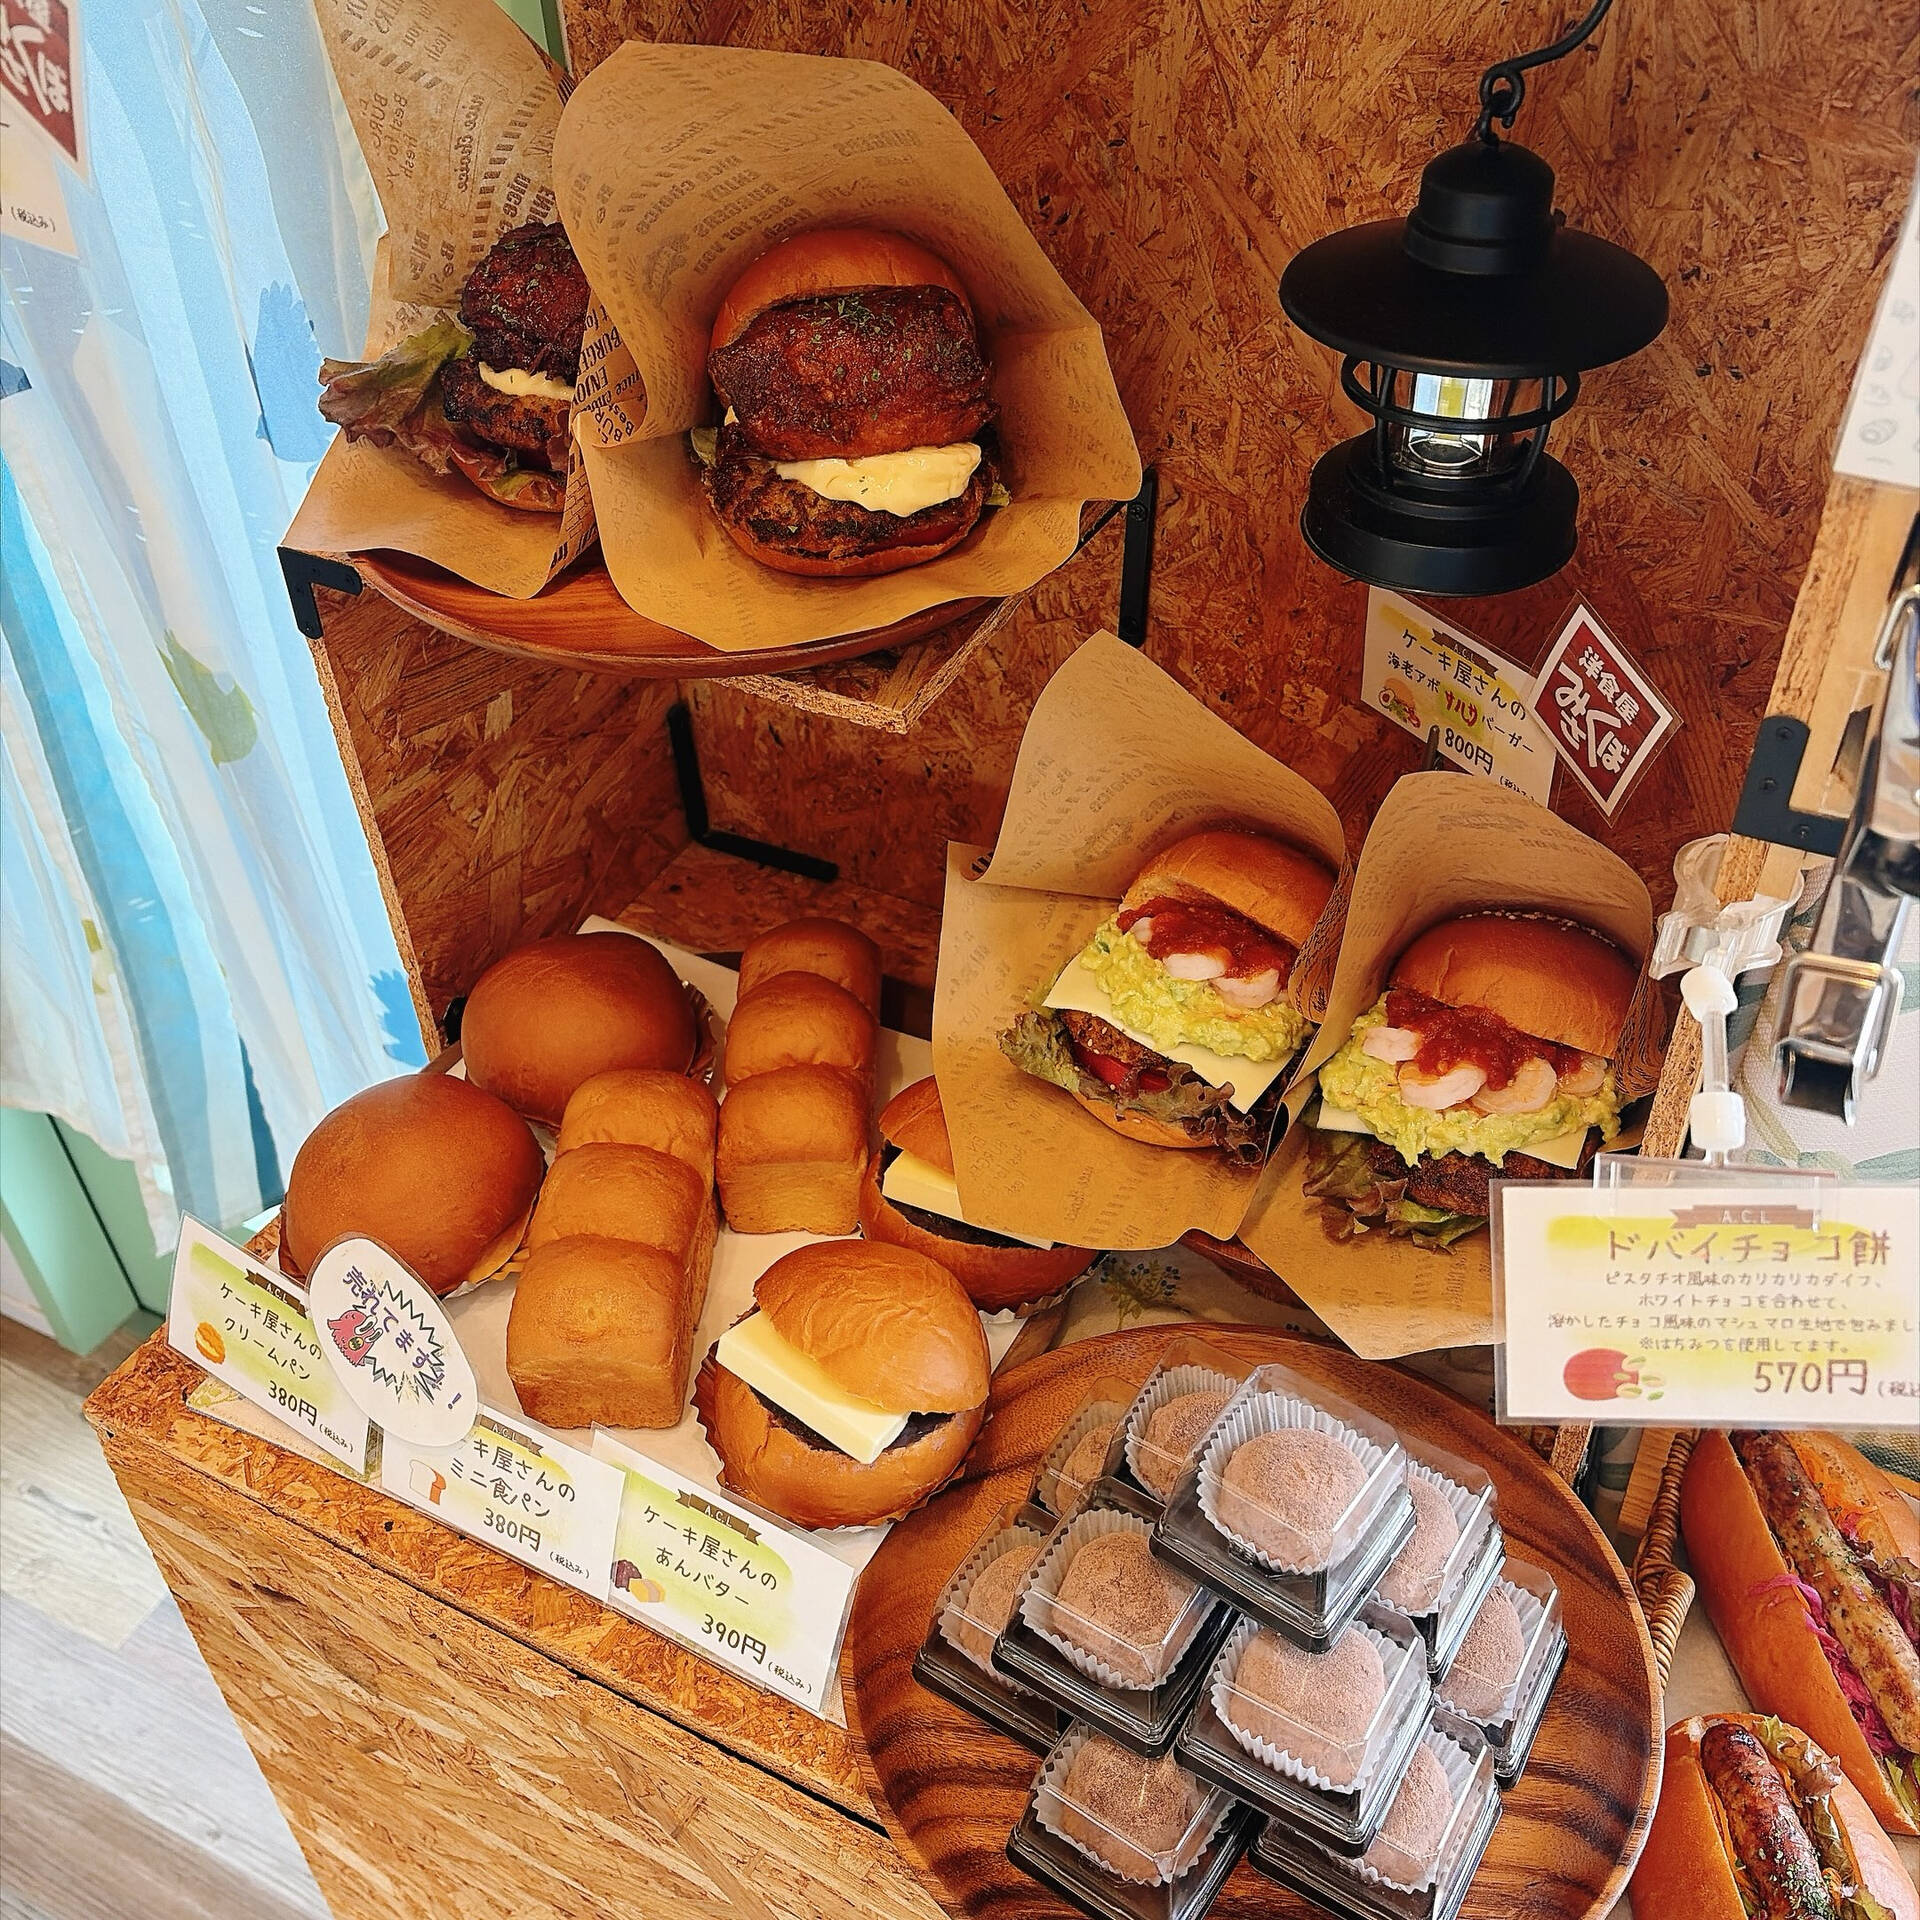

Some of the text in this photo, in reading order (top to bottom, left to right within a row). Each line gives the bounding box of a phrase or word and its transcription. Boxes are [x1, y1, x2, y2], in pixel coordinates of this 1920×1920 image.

[1402, 629, 1526, 721] ケーキ屋さんの
[1578, 645, 1640, 727] 洋食屋
[1445, 727, 1494, 776] 800円
[1610, 1229, 1891, 1267] ドバイチョコ餅
[220, 1283, 322, 1360] ケーキ屋さんの
[225, 1318, 310, 1380] クリームパン
[1548, 1313, 1920, 1332] 溶かしたチョコ風味のマシュマロ生地で包みまし
[268, 1380, 317, 1427] 380円
[1753, 1359, 1868, 1395] 570円
[451, 1457, 550, 1517] ミニ食パン
[483, 1507, 541, 1552] 380円
[644, 1505, 777, 1590] ケーキ屋さんの
[656, 1547, 749, 1605] あんバター
[701, 1613, 767, 1665] 390円
